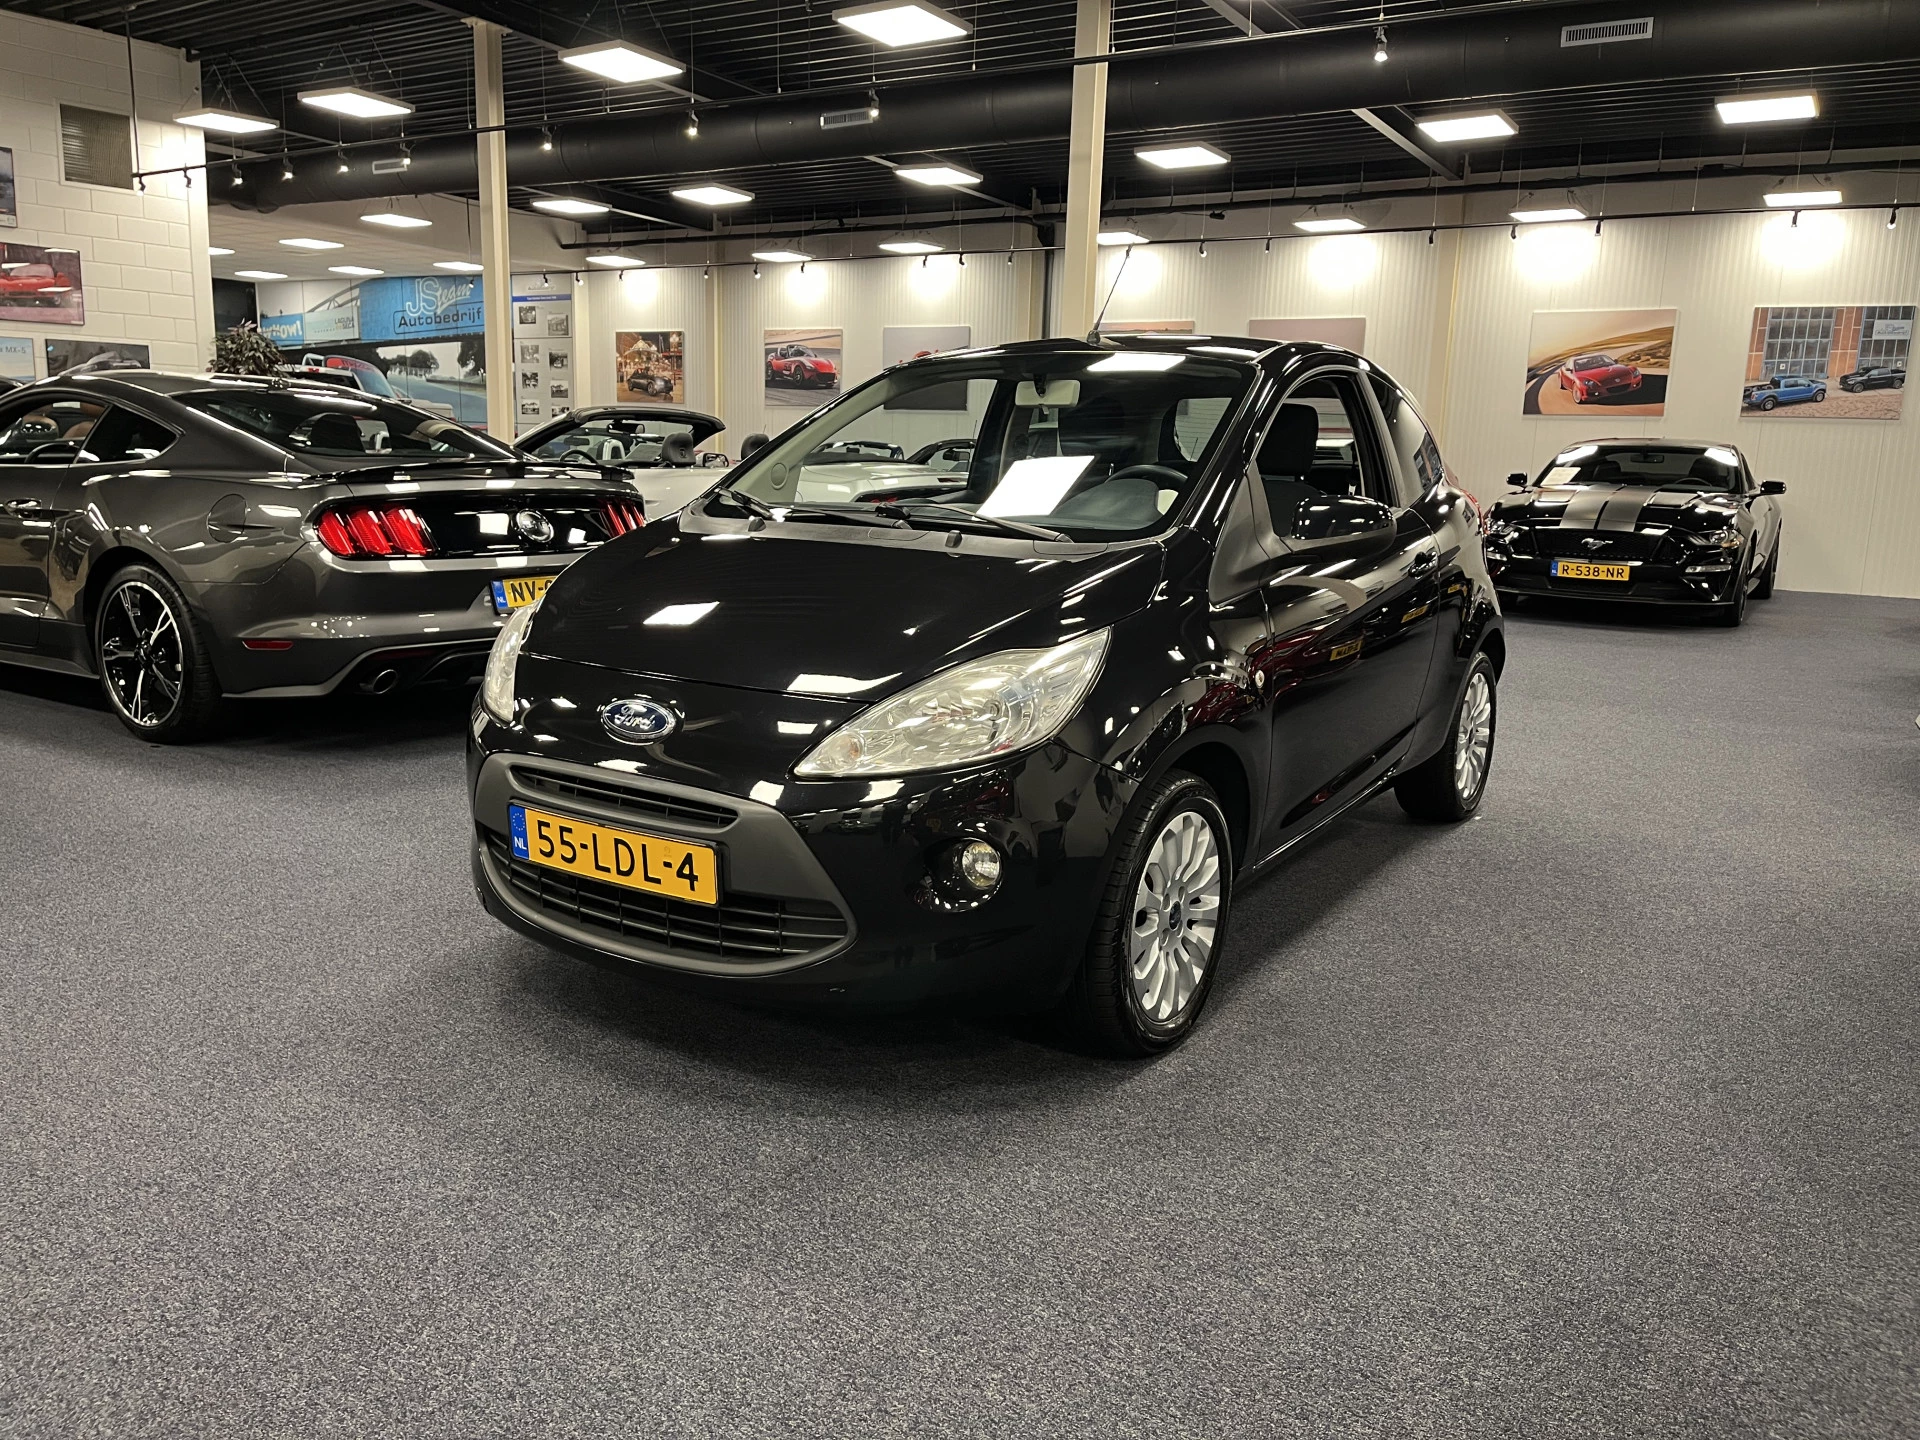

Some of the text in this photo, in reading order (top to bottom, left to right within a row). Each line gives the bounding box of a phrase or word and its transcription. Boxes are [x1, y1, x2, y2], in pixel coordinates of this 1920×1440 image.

[398, 306, 483, 328] Autobedrijf
[1562, 564, 1625, 579] R-538-NR
[614, 705, 656, 730] Ford
[514, 835, 527, 850] NL
[537, 820, 699, 892] 55-LDL-4
